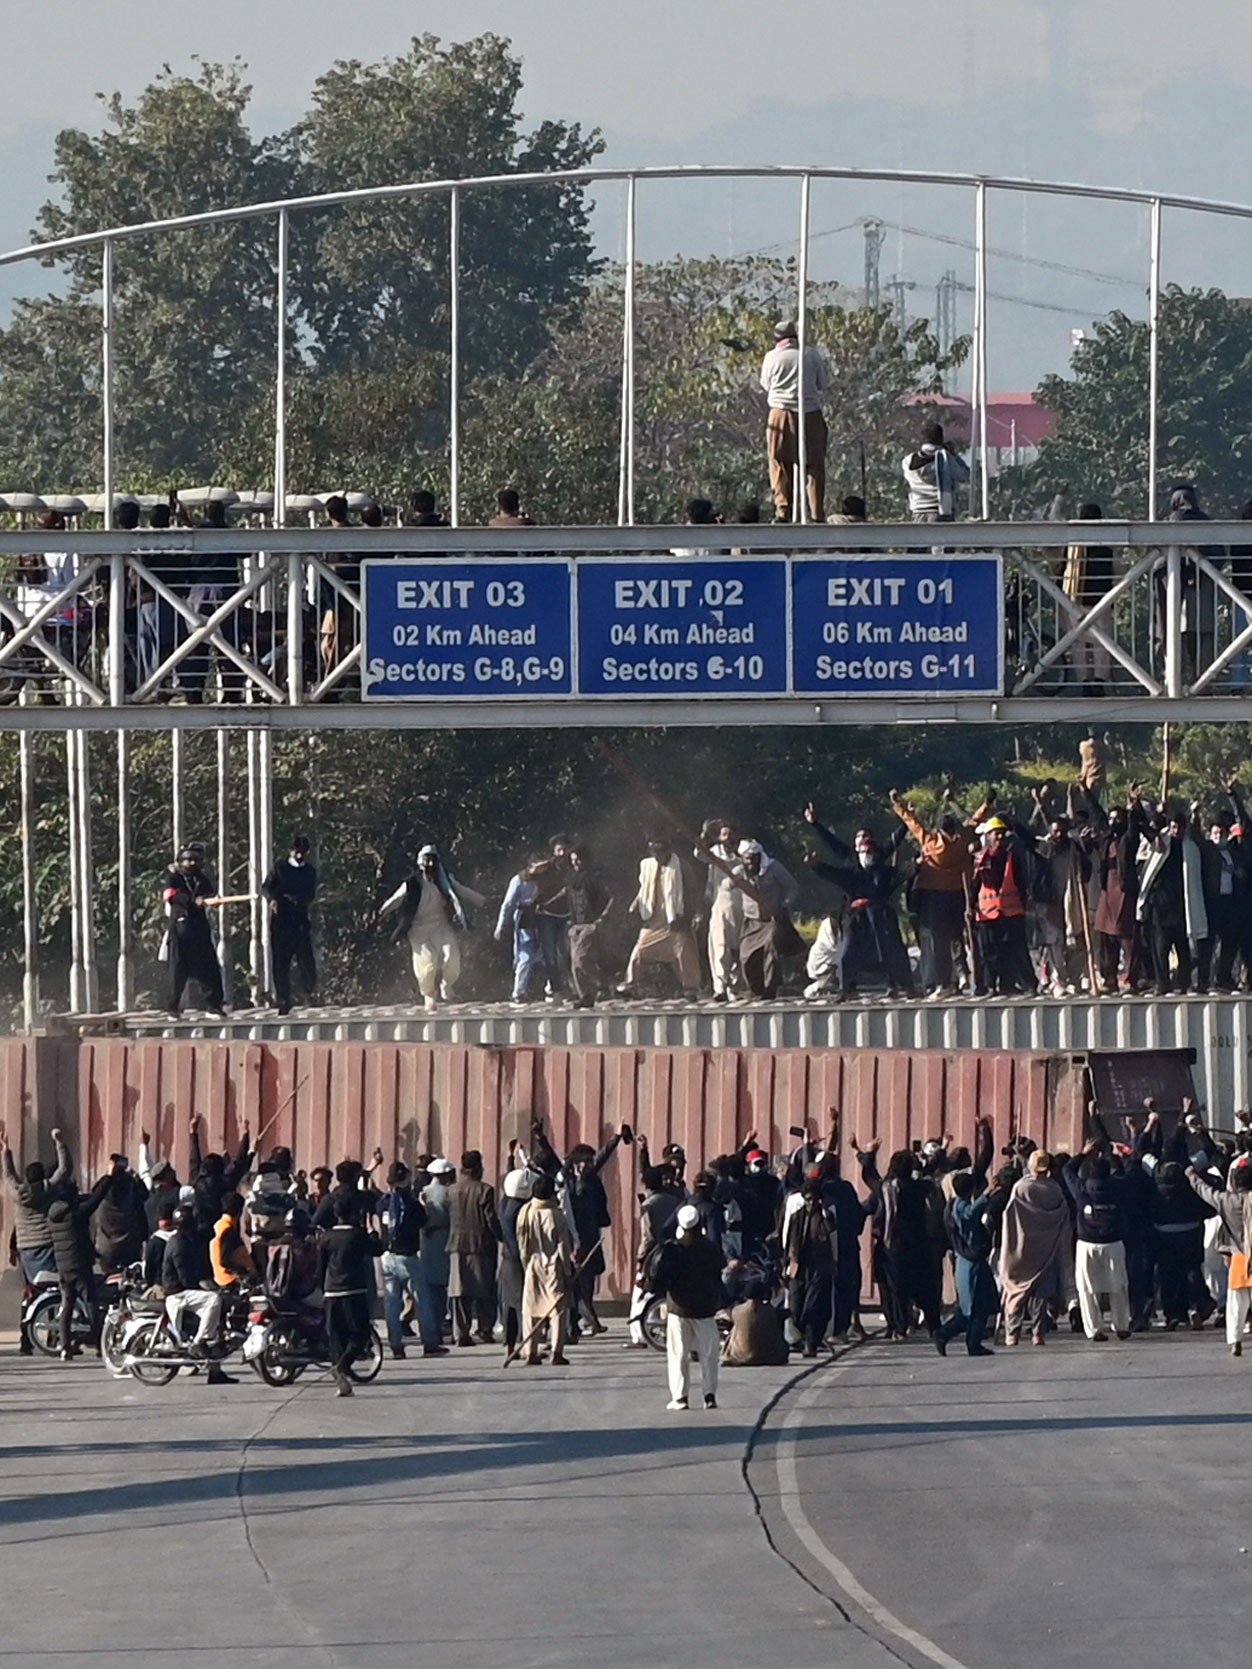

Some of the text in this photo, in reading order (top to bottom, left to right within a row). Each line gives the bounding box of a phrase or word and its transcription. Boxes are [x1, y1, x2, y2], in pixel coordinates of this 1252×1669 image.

[397, 580, 526, 609] EXIT 03
[615, 579, 744, 609] EXIT 02
[827, 577, 953, 606] EXIT 01
[393, 624, 536, 646] 02 Km Ahead
[610, 622, 754, 645] 04 Km Ahead
[823, 621, 967, 643] 06 Km Ahead
[368, 656, 565, 685] Sectors G-8,G-9
[602, 657, 698, 681] Sectors
[816, 653, 975, 679] Sectors G-11
